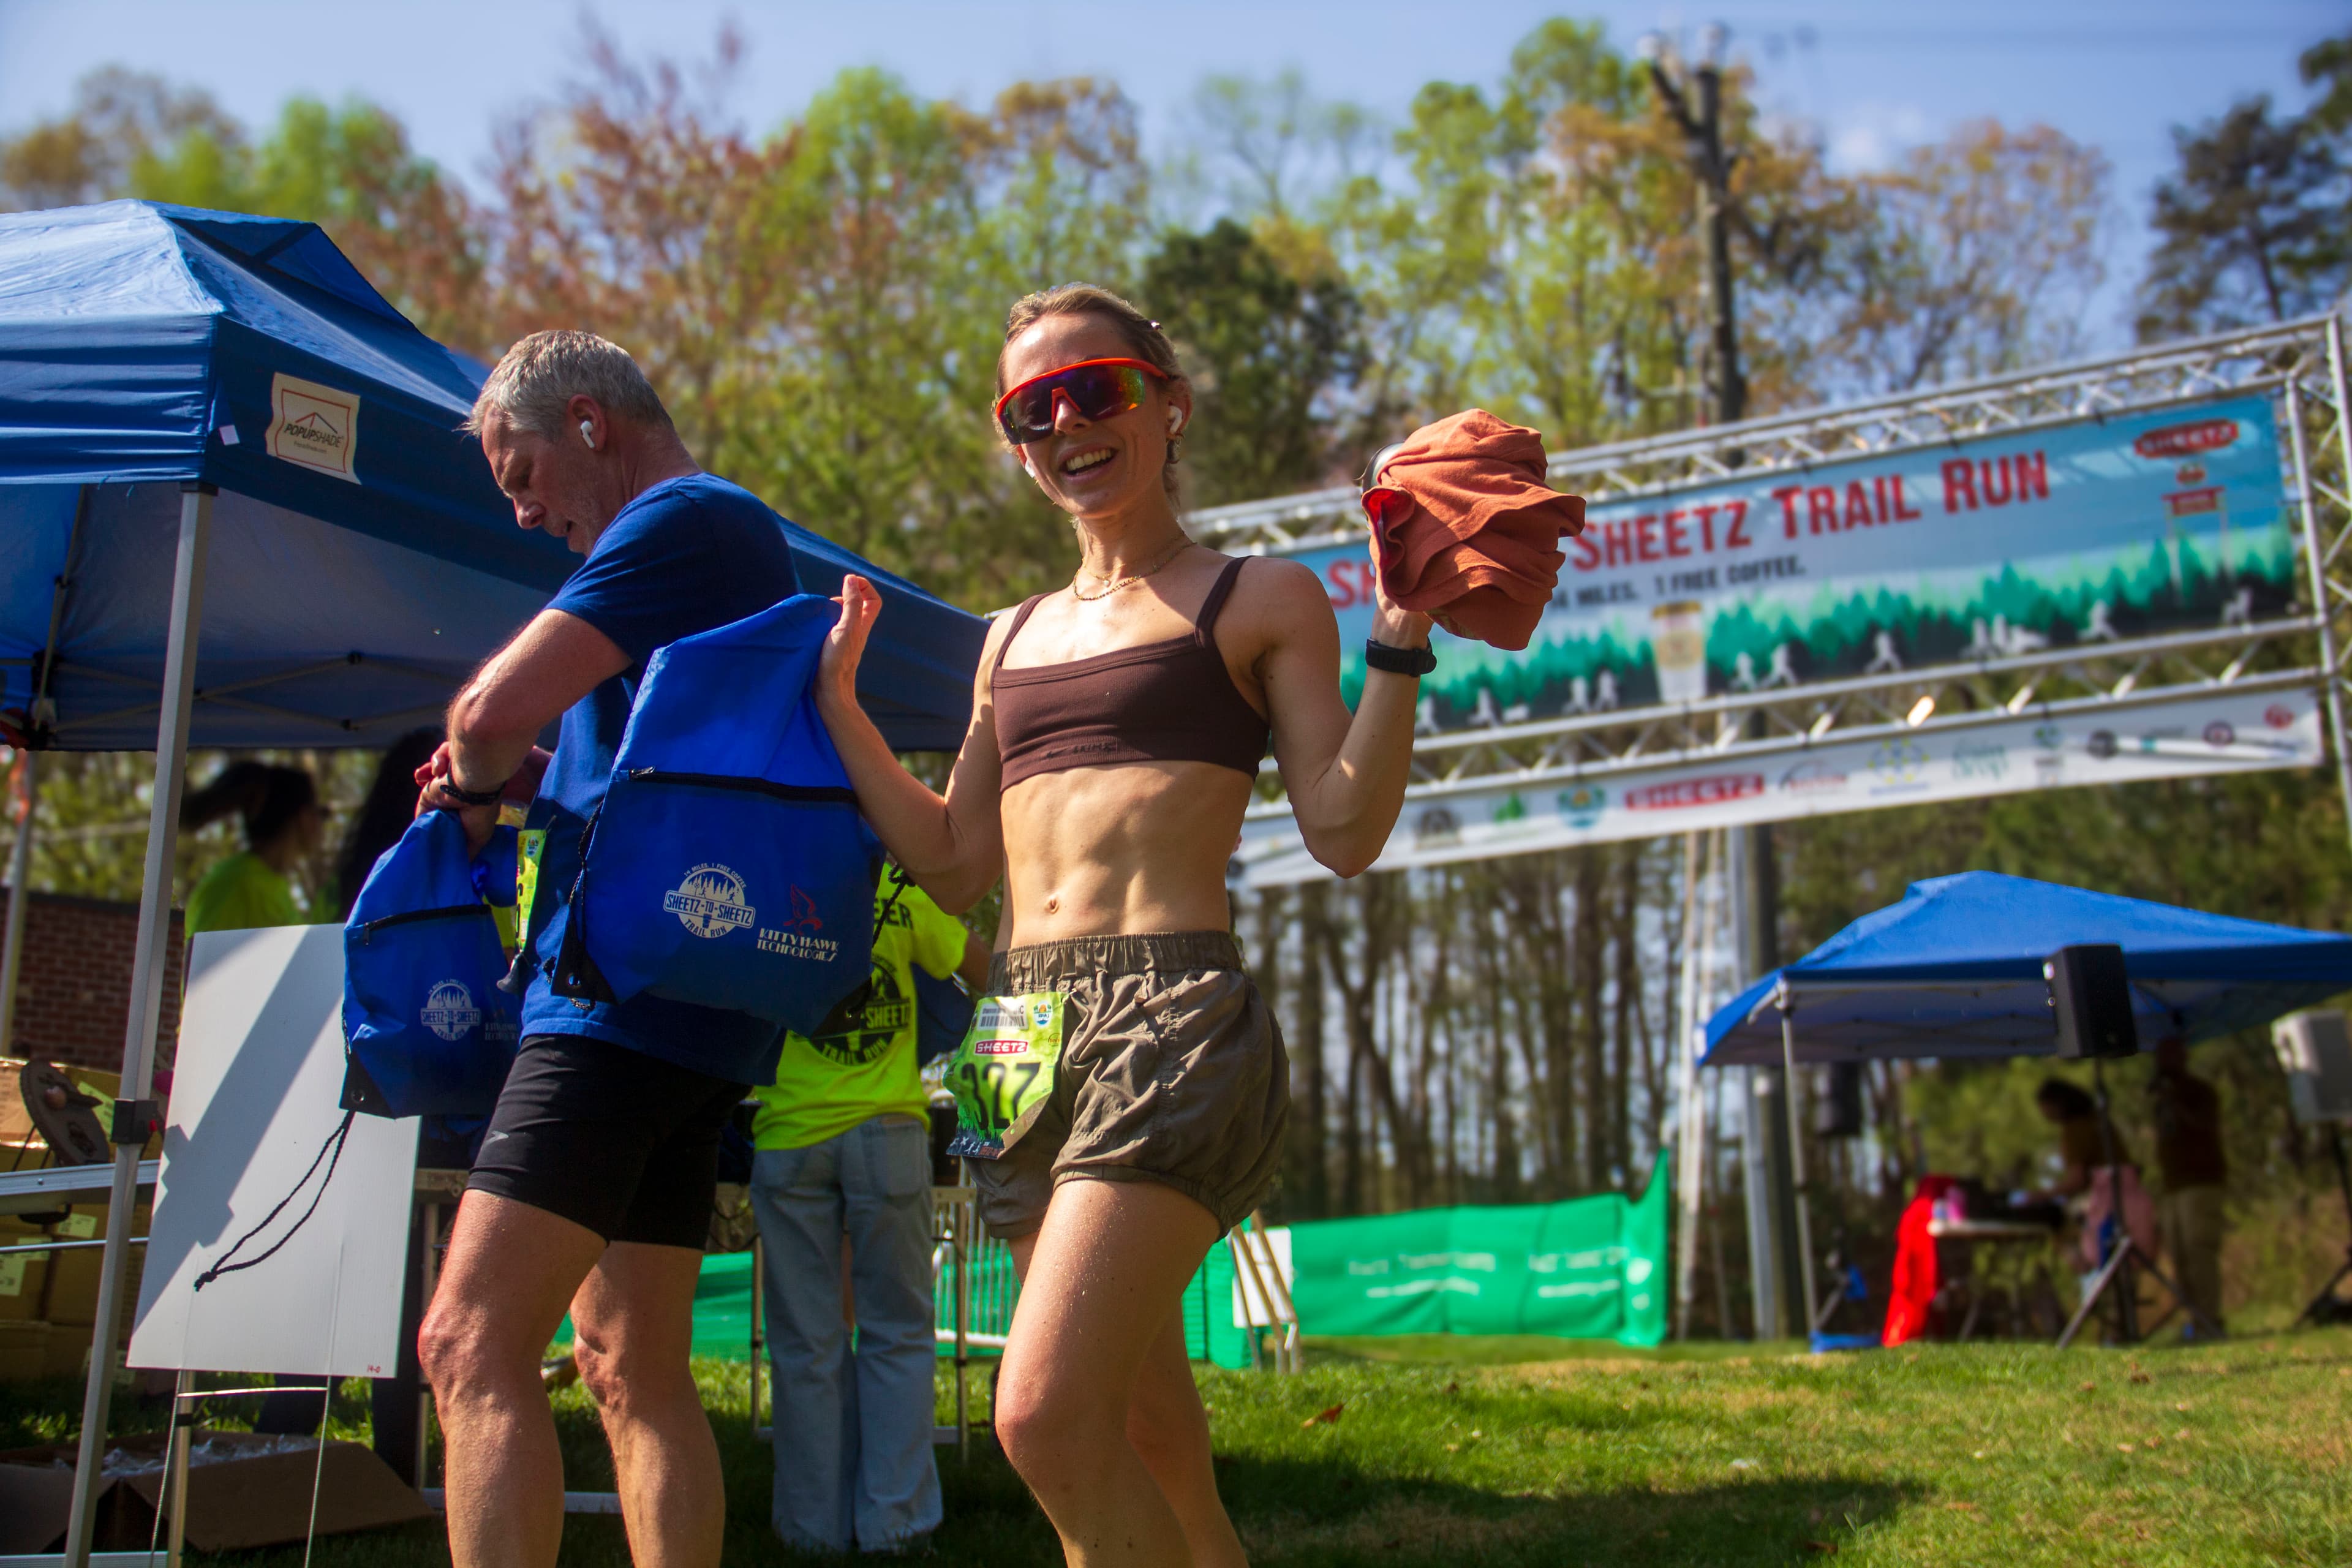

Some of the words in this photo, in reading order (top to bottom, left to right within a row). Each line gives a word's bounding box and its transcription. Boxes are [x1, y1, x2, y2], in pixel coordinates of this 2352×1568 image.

[1574, 501, 1751, 570] SHEETZ
[1772, 475, 1920, 538] TRAIL
[1941, 450, 2048, 513] RUN
[1672, 565, 1717, 594] FREE
[1727, 554, 1806, 584] COFFEE.
[717, 864, 731, 873] FREE
[684, 919, 706, 937] TRAIL
[710, 925, 727, 938] RUN
[759, 928, 799, 946] KITTY
[800, 936, 840, 952] HAWK
[822, 1042, 858, 1066] TRAIL
[863, 1038, 888, 1063] RUN
[977, 1042, 1027, 1053] SHEETZ
